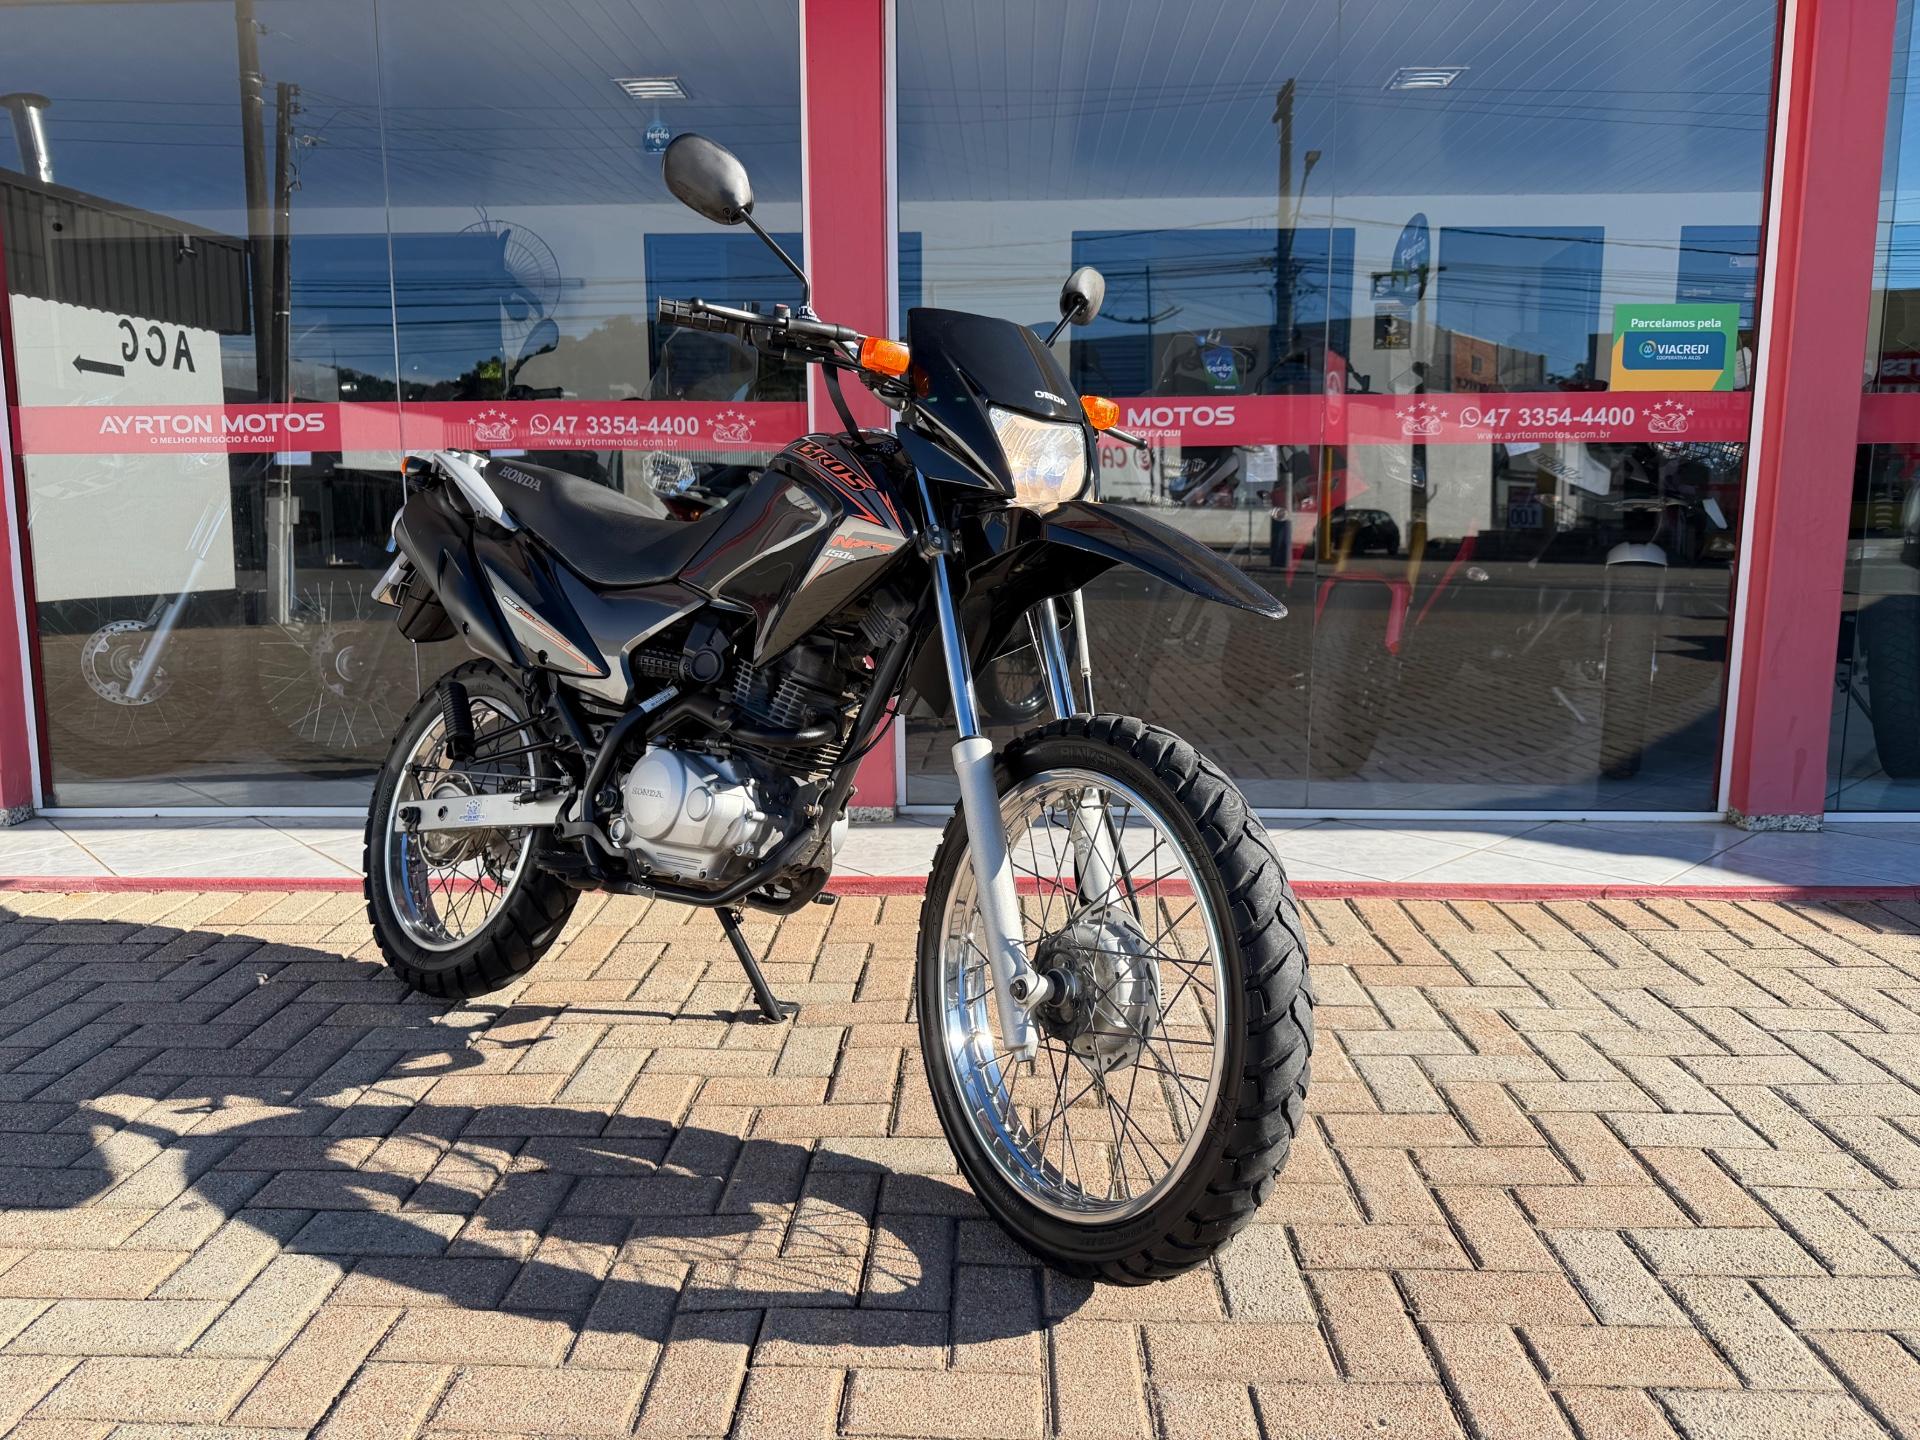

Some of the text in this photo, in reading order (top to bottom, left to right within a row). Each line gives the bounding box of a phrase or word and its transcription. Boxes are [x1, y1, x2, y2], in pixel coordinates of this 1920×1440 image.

[1631, 318, 1722, 330] Parcelamos pela
[1657, 344, 1709, 355] VIACREDI
[1127, 406, 1235, 427] MOTOS
[1483, 407, 1635, 427] 47 3354-4400
[99, 412, 326, 434] AYRTON MOTOS
[552, 416, 699, 436] 47 3354-4400
[1156, 429, 1181, 437] AQUI
[1477, 430, 1611, 441] www.ayrtonmotos.com.br
[199, 435, 242, 444] NEGÓCIO
[250, 435, 275, 443] AQUI
[548, 437, 678, 448] www.ayrtonmotos.com.br
[792, 440, 869, 491] BROS
[499, 465, 541, 491] HONDA
[631, 787, 664, 799] HONDA
